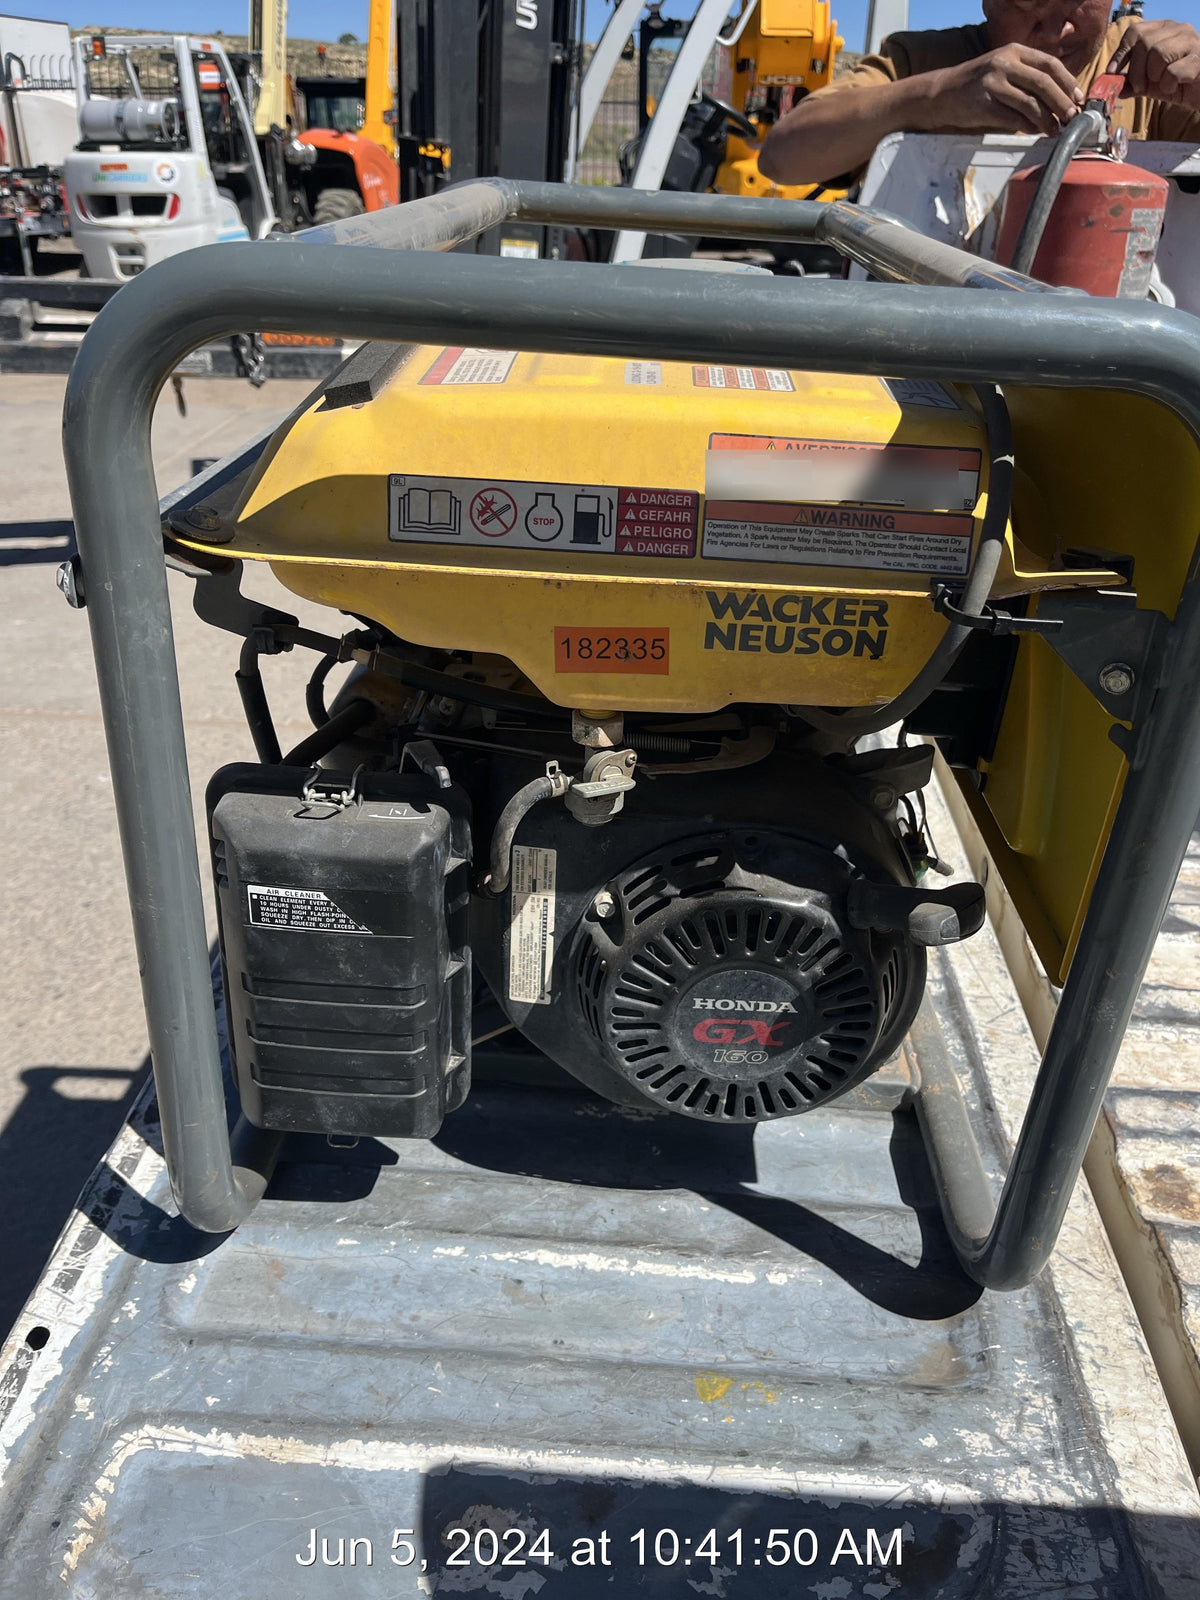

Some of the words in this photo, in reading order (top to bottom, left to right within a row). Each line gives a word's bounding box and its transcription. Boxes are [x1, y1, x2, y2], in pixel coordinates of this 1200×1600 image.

[640, 492, 692, 507] DANGER
[533, 516, 555, 526] STOP
[639, 509, 692, 523] GEFAHR
[811, 509, 895, 530] WARNING
[634, 525, 692, 540] PELIGRO
[707, 522, 738, 530] Operation
[749, 524, 762, 532] This
[764, 526, 797, 534] Equipment
[800, 528, 812, 536] May
[837, 530, 860, 538] Sparks
[862, 532, 875, 540] That
[892, 534, 907, 542] Start
[950, 538, 962, 546] Dry
[638, 542, 689, 556] DANGER
[707, 531, 742, 540] Vegetation.
[750, 534, 768, 542] Spark
[898, 542, 921, 550] Should
[922, 544, 948, 552] Contact
[949, 546, 966, 554] Local
[720, 540, 748, 548] Agencies
[762, 542, 779, 550] Laws
[789, 544, 826, 552] Regulations
[828, 546, 854, 556] Relating
[705, 591, 889, 627] WACKER
[704, 622, 888, 657] NEUSON
[561, 636, 666, 661] 182335
[266, 888, 280, 896] AIR
[285, 890, 322, 899] CLEANER
[260, 912, 288, 920] SQUEEZE
[290, 920, 316, 928] SQUEEZE
[692, 998, 798, 1013] HONDA
[693, 1018, 792, 1046] GX
[713, 1049, 769, 1064] 160
